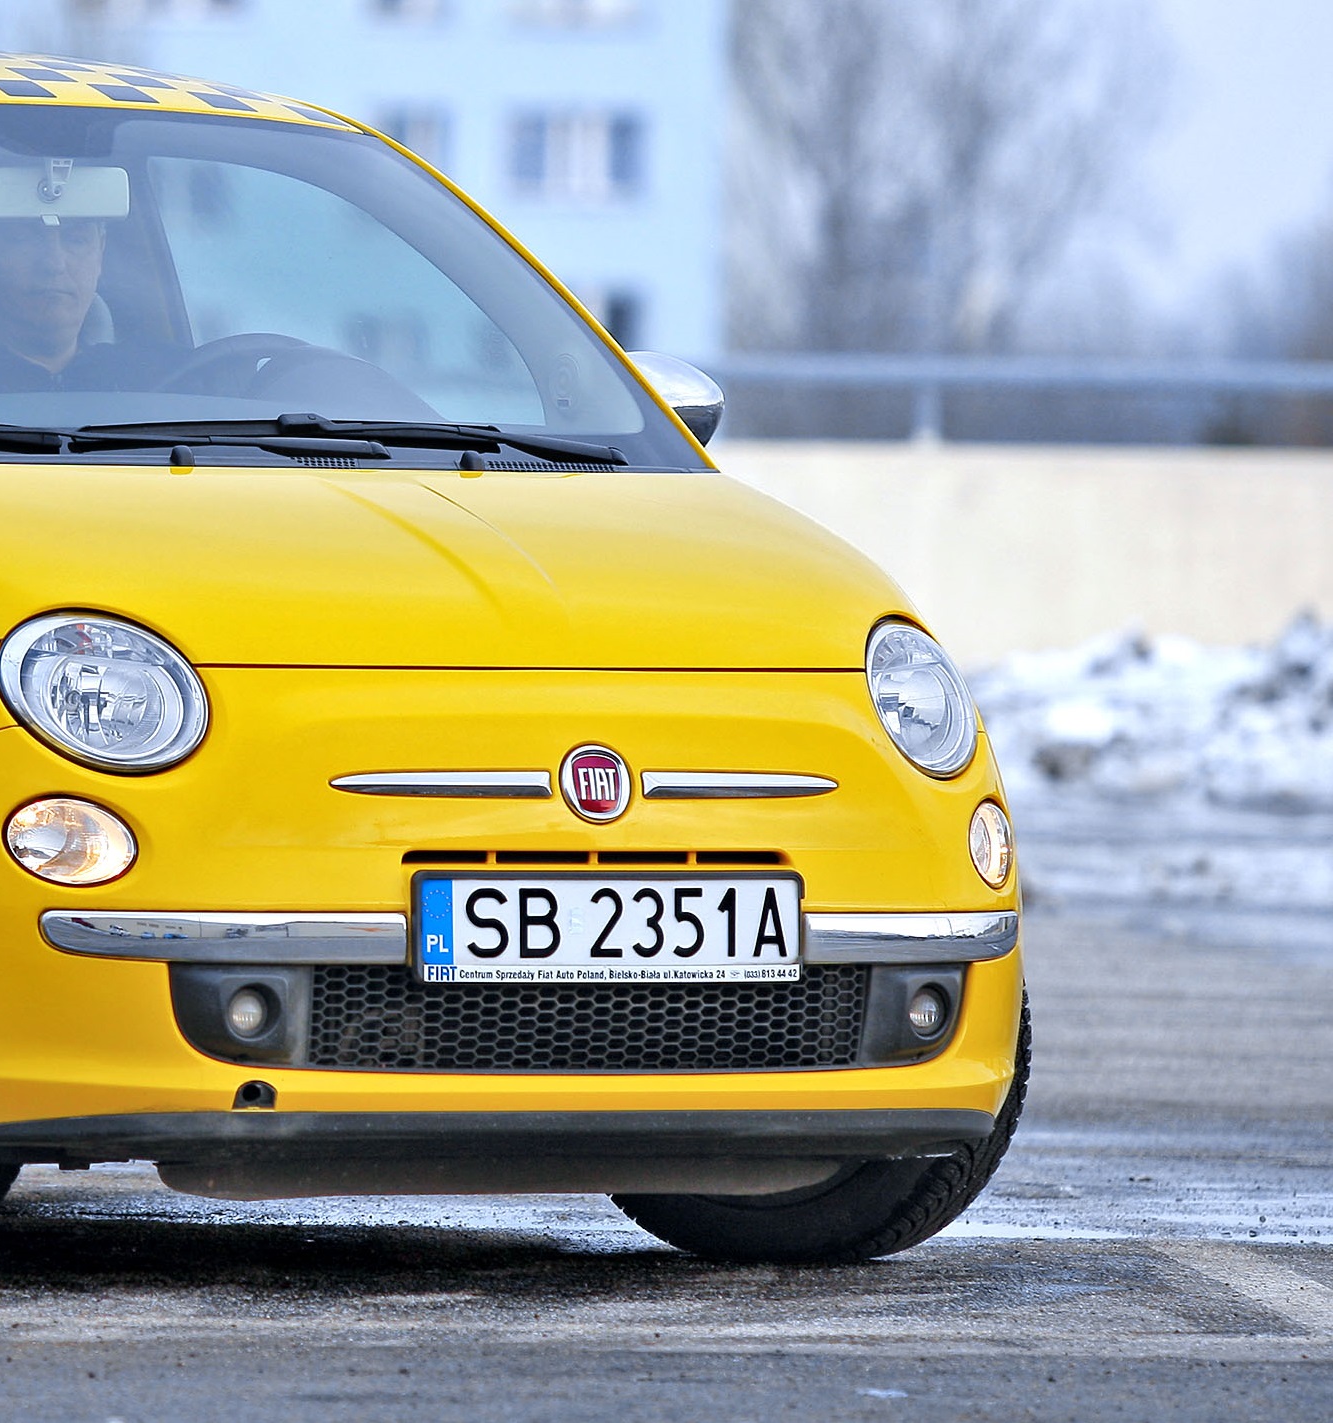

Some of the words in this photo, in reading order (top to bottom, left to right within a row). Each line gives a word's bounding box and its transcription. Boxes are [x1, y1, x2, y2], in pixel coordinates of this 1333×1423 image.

[577, 767, 617, 801] FIAT
[465, 887, 561, 959] SB
[590, 887, 788, 959] 2351A
[426, 934, 450, 953] PL
[427, 965, 458, 981] FIAT
[459, 969, 493, 979] Centrum
[537, 969, 554, 979] Fiat
[556, 969, 575, 979] Auto
[577, 969, 607, 981] Poland,
[716, 969, 726, 979] 24
[761, 968, 776, 979] 813
[777, 968, 787, 978] 44
[787, 968, 798, 978] 42
